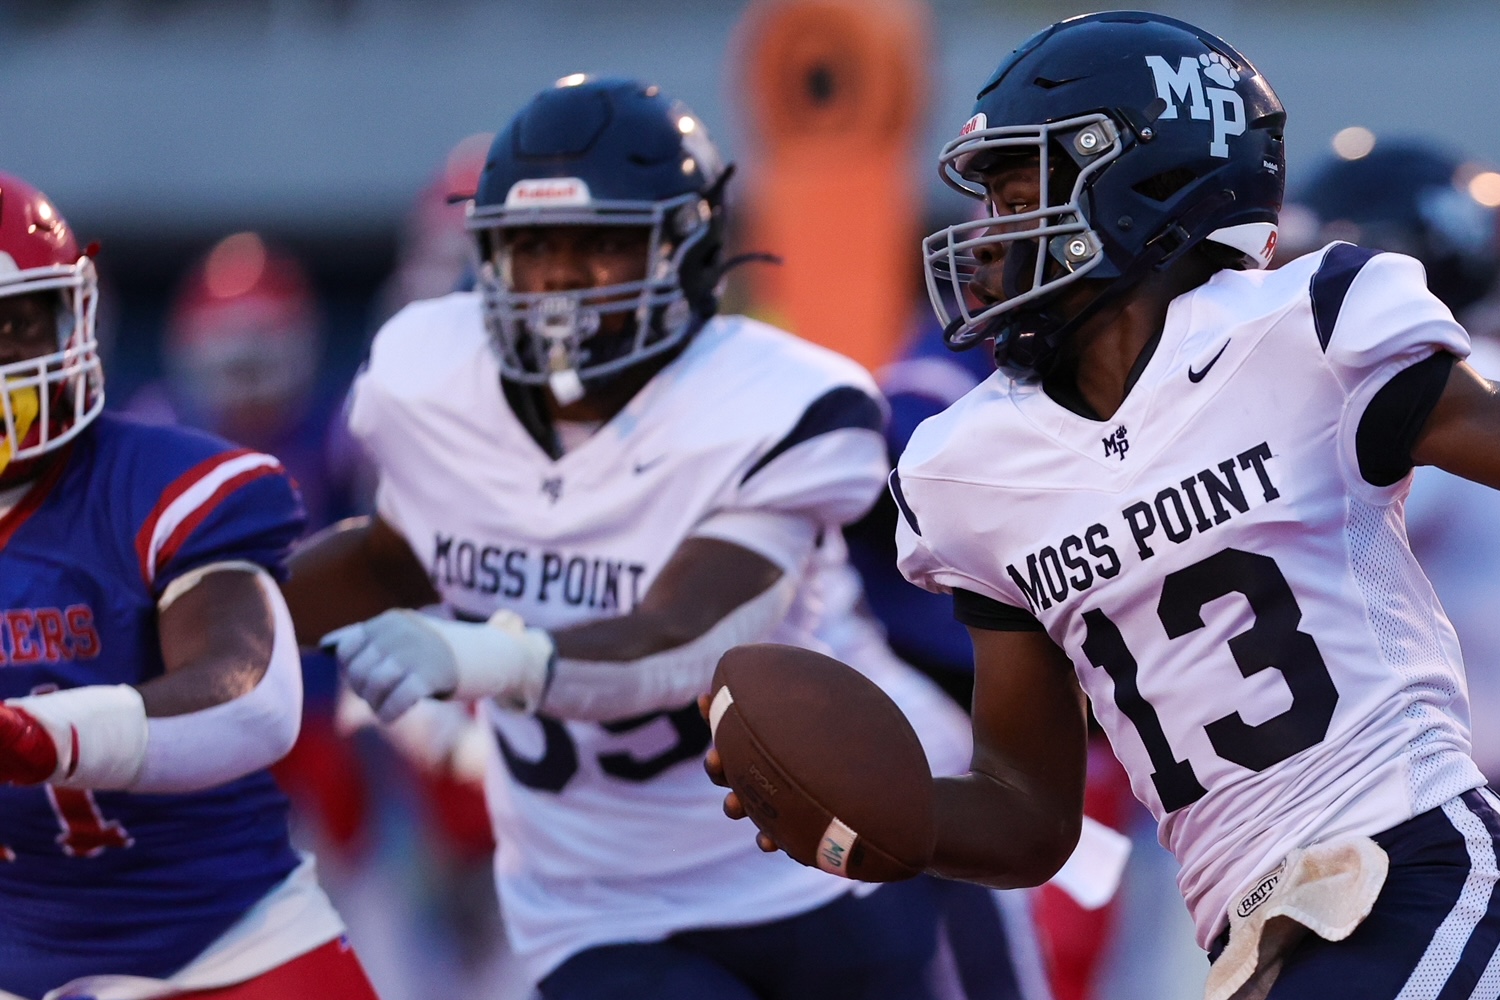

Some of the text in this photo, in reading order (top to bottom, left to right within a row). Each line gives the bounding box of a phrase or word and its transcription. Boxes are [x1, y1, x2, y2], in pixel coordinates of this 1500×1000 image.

[1101, 432, 1130, 461] MP
[432, 532, 646, 612] MOSS POINT
[1006, 441, 1281, 616] MOSS POINT
[1081, 547, 1340, 814] 13
